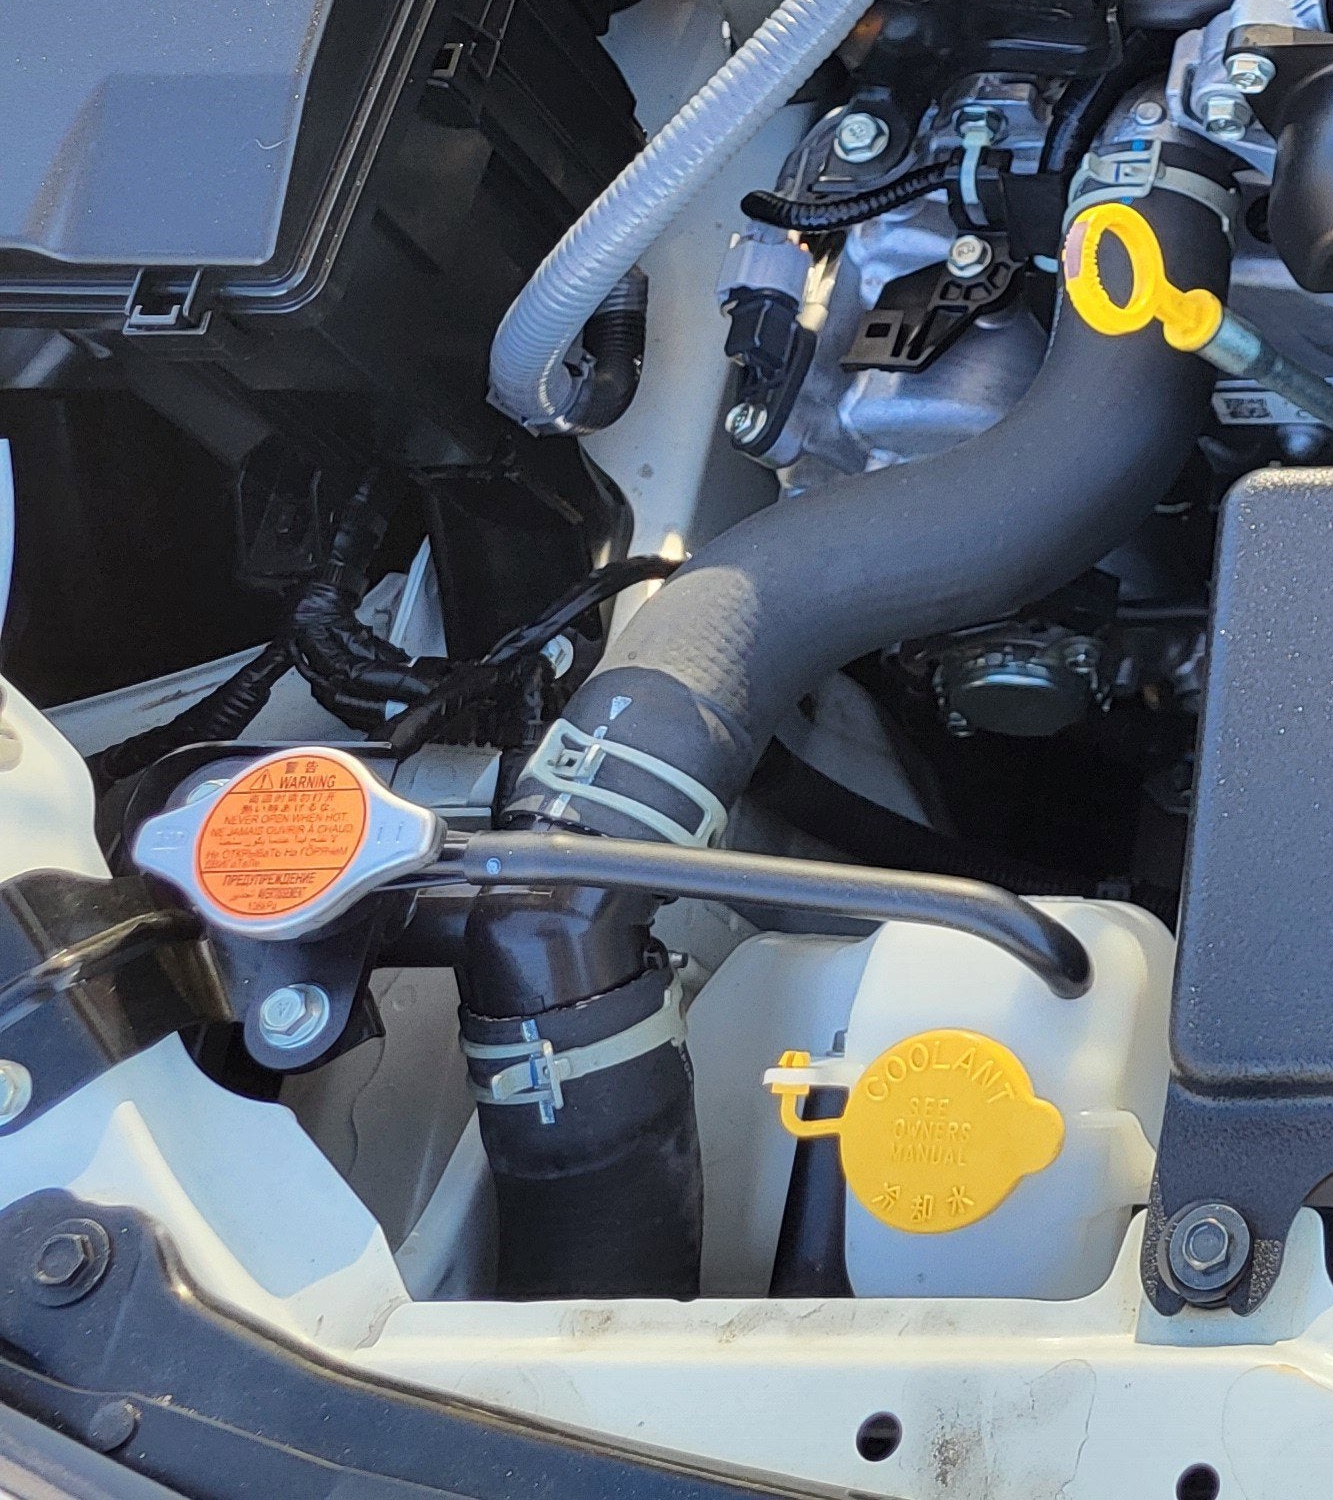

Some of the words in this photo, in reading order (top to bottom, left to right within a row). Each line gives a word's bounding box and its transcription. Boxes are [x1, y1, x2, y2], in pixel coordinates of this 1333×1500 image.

[279, 774, 336, 789] WARNING
[224, 814, 257, 824] NEVER
[260, 813, 288, 823] OPEN
[292, 812, 322, 822] WHEN
[325, 812, 347, 821] HOT
[227, 826, 262, 836] JAMAIS
[865, 1039, 1017, 1106] COOLANT
[908, 1096, 950, 1119] SEE
[894, 1117, 973, 1144] OWNERS
[889, 1141, 967, 1168] MANUAL
